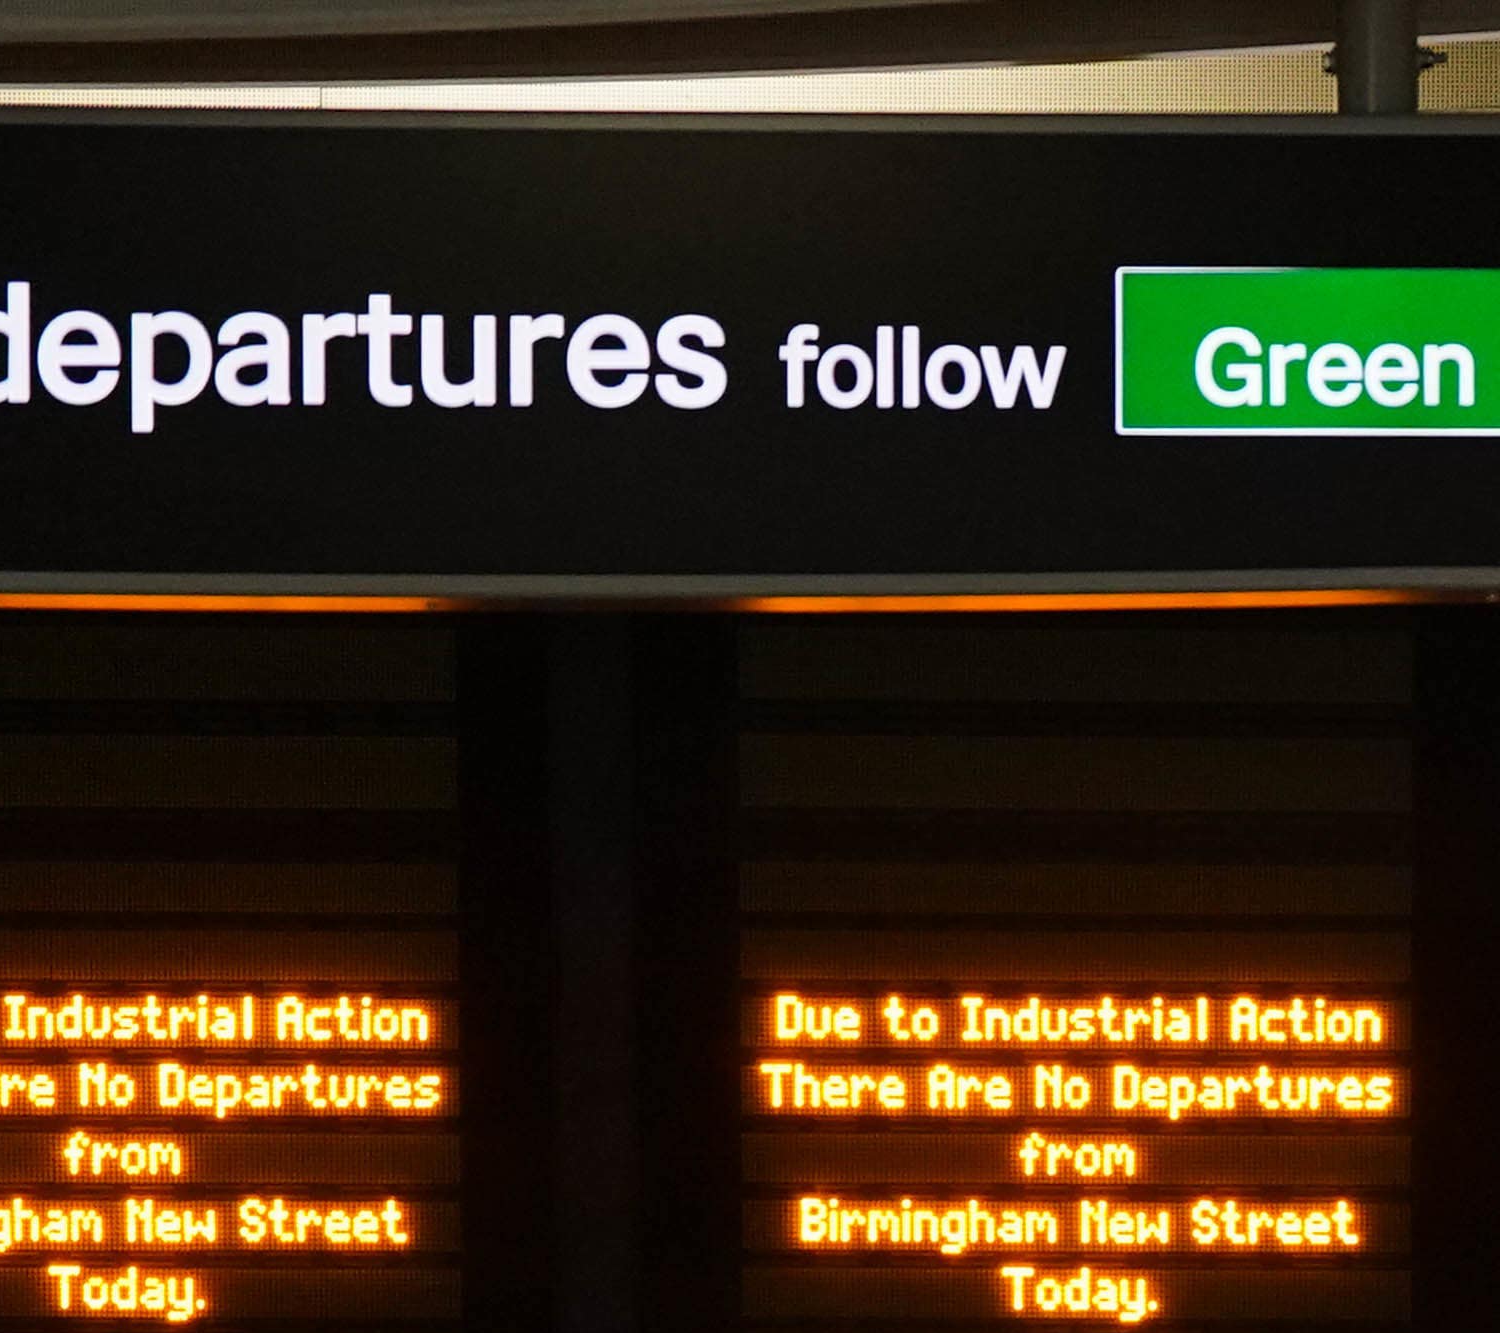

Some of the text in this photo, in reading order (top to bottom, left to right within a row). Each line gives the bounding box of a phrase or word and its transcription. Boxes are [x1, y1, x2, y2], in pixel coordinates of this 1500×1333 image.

[778, 323, 1067, 410] follow
[1195, 327, 1474, 407] Green
[3, 994, 255, 1042] Industrial
[273, 995, 430, 1042] Action
[774, 994, 1383, 1043] Due to Industrial Action
[76, 1062, 136, 1108] No
[156, 1062, 441, 1118] Departures
[759, 1062, 1393, 1120] There Are No Departures
[61, 1131, 183, 1176] from
[1018, 1132, 1136, 1177] from
[124, 1198, 218, 1244] New
[238, 1198, 408, 1244] Street
[798, 1197, 1359, 1255] Birmingham New Street
[47, 1264, 206, 1322] Today.
[1000, 1266, 1159, 1322] Today.
